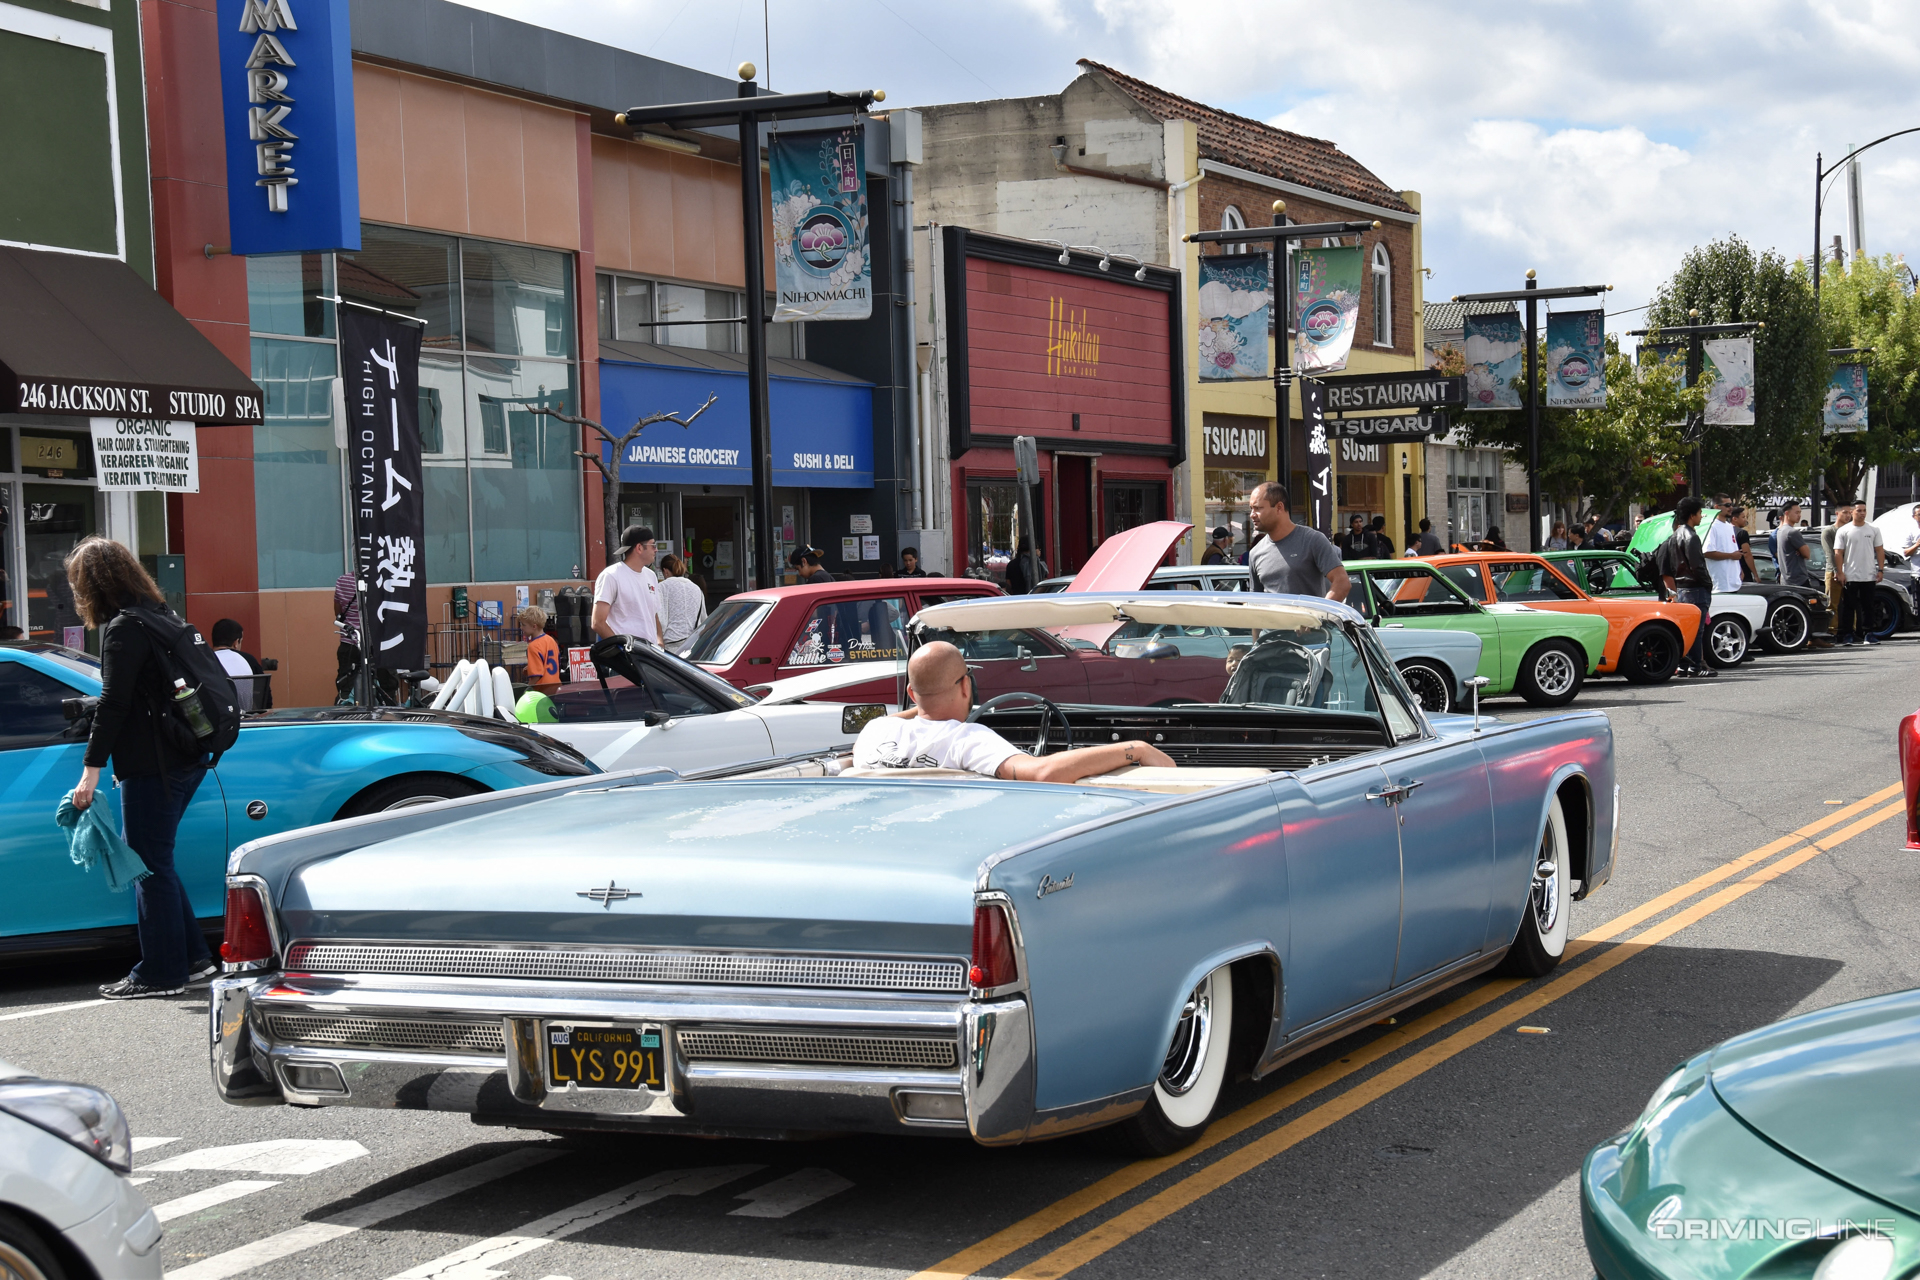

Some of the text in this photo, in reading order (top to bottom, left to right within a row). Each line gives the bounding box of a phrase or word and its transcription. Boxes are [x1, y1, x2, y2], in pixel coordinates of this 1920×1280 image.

[239, 0, 299, 212] MARKET
[843, 148, 855, 188] 日本町
[782, 287, 866, 304] NIHONMACHI
[1047, 296, 1099, 378] Hukilau
[1081, 367, 1097, 377] JOSE
[362, 360, 375, 417] HIGH
[1328, 381, 1449, 408] RESTAURANT
[20, 383, 262, 419] 246 JACKSON ST. STUDIO SPA
[1550, 396, 1603, 405] NIHONMACHI
[116, 418, 172, 437] ORGANIC
[1330, 415, 1434, 436] TSUGARU
[39, 446, 62, 458] 246
[97, 437, 114, 452] HAIR
[115, 438, 135, 453] COLOR
[136, 438, 142, 452] &
[1203, 425, 1267, 458] TSUGARU
[1341, 438, 1380, 463] SUSHI
[628, 445, 740, 466] JAPANESE GROCERY
[793, 452, 855, 470] SUSHI & DELI
[104, 471, 141, 486] KERATIN
[360, 430, 375, 519] OCTANE
[546, 650, 558, 676] 5
[552, 1033, 569, 1043] AUG
[577, 1032, 632, 1043] CALIFORNIA
[552, 1047, 660, 1085] LYS 991
